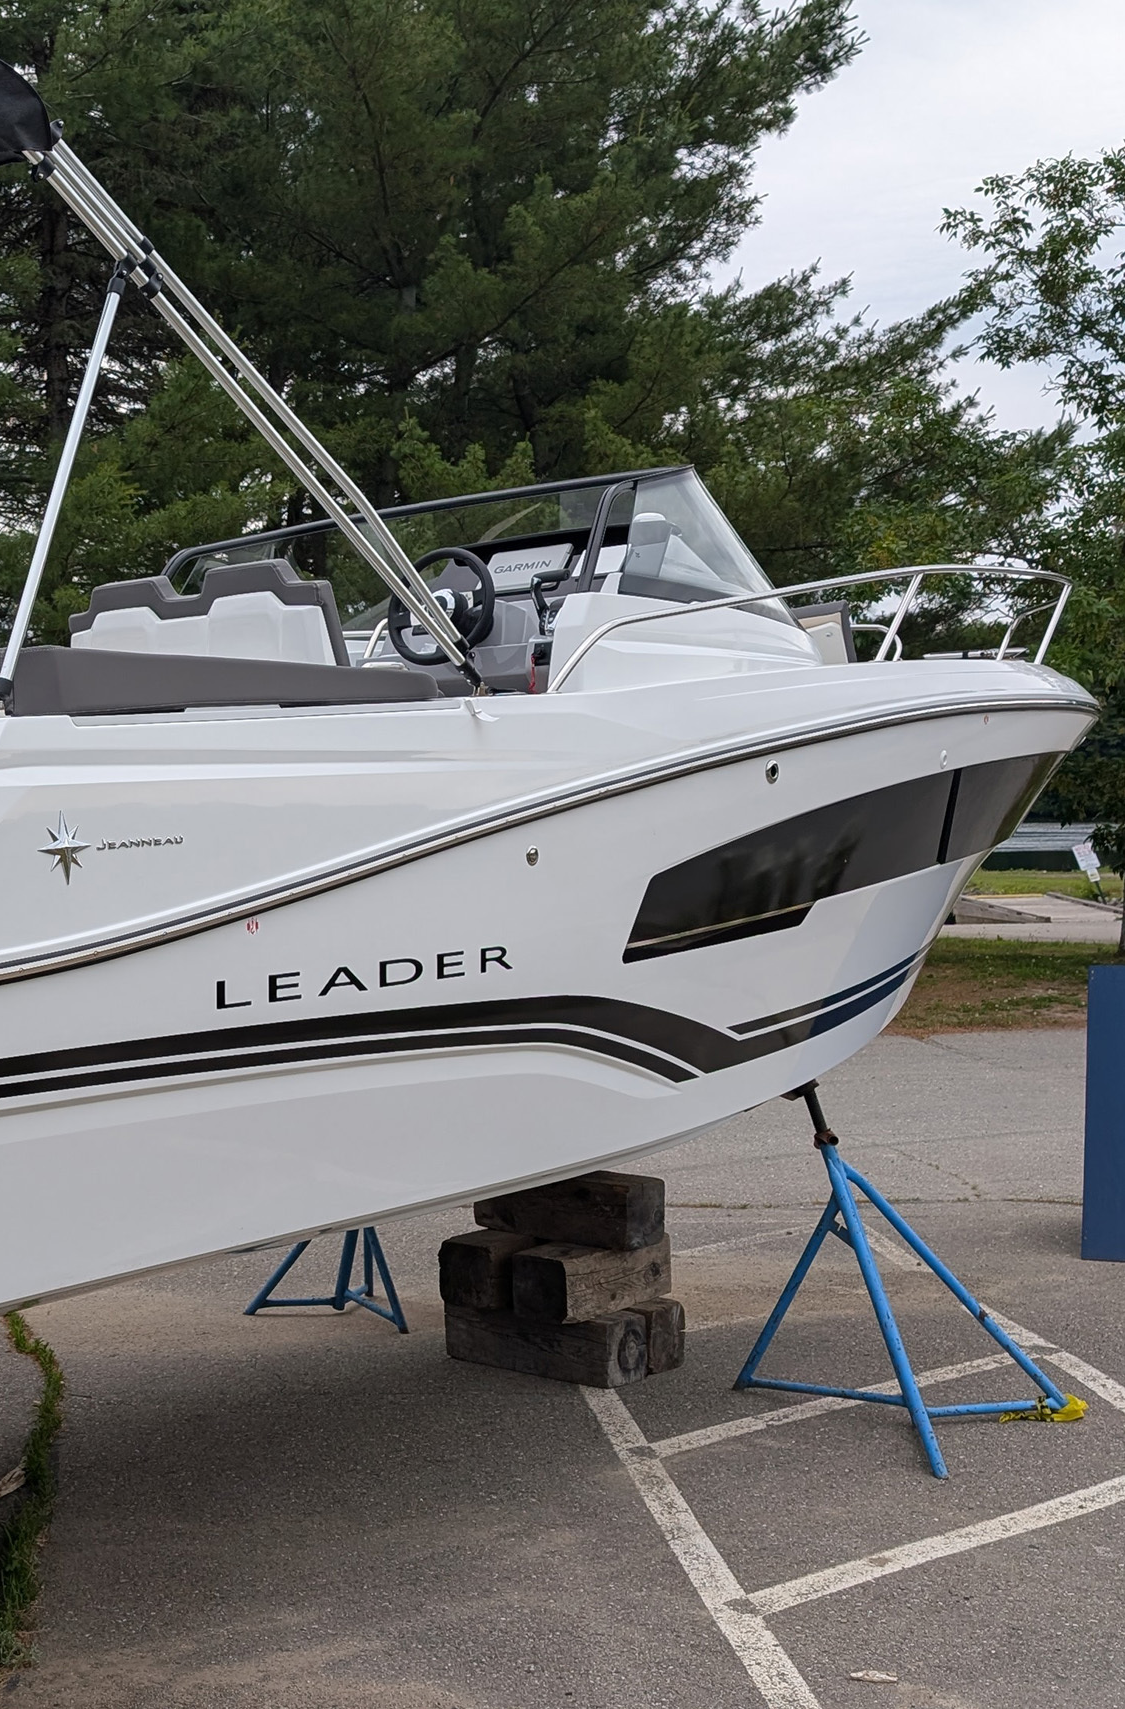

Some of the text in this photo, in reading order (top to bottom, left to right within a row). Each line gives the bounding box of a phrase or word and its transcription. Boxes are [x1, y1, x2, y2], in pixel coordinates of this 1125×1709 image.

[494, 560, 552, 574] GARMIN
[96, 836, 184, 851] JEANNEAU
[216, 946, 514, 1010] LEADER
